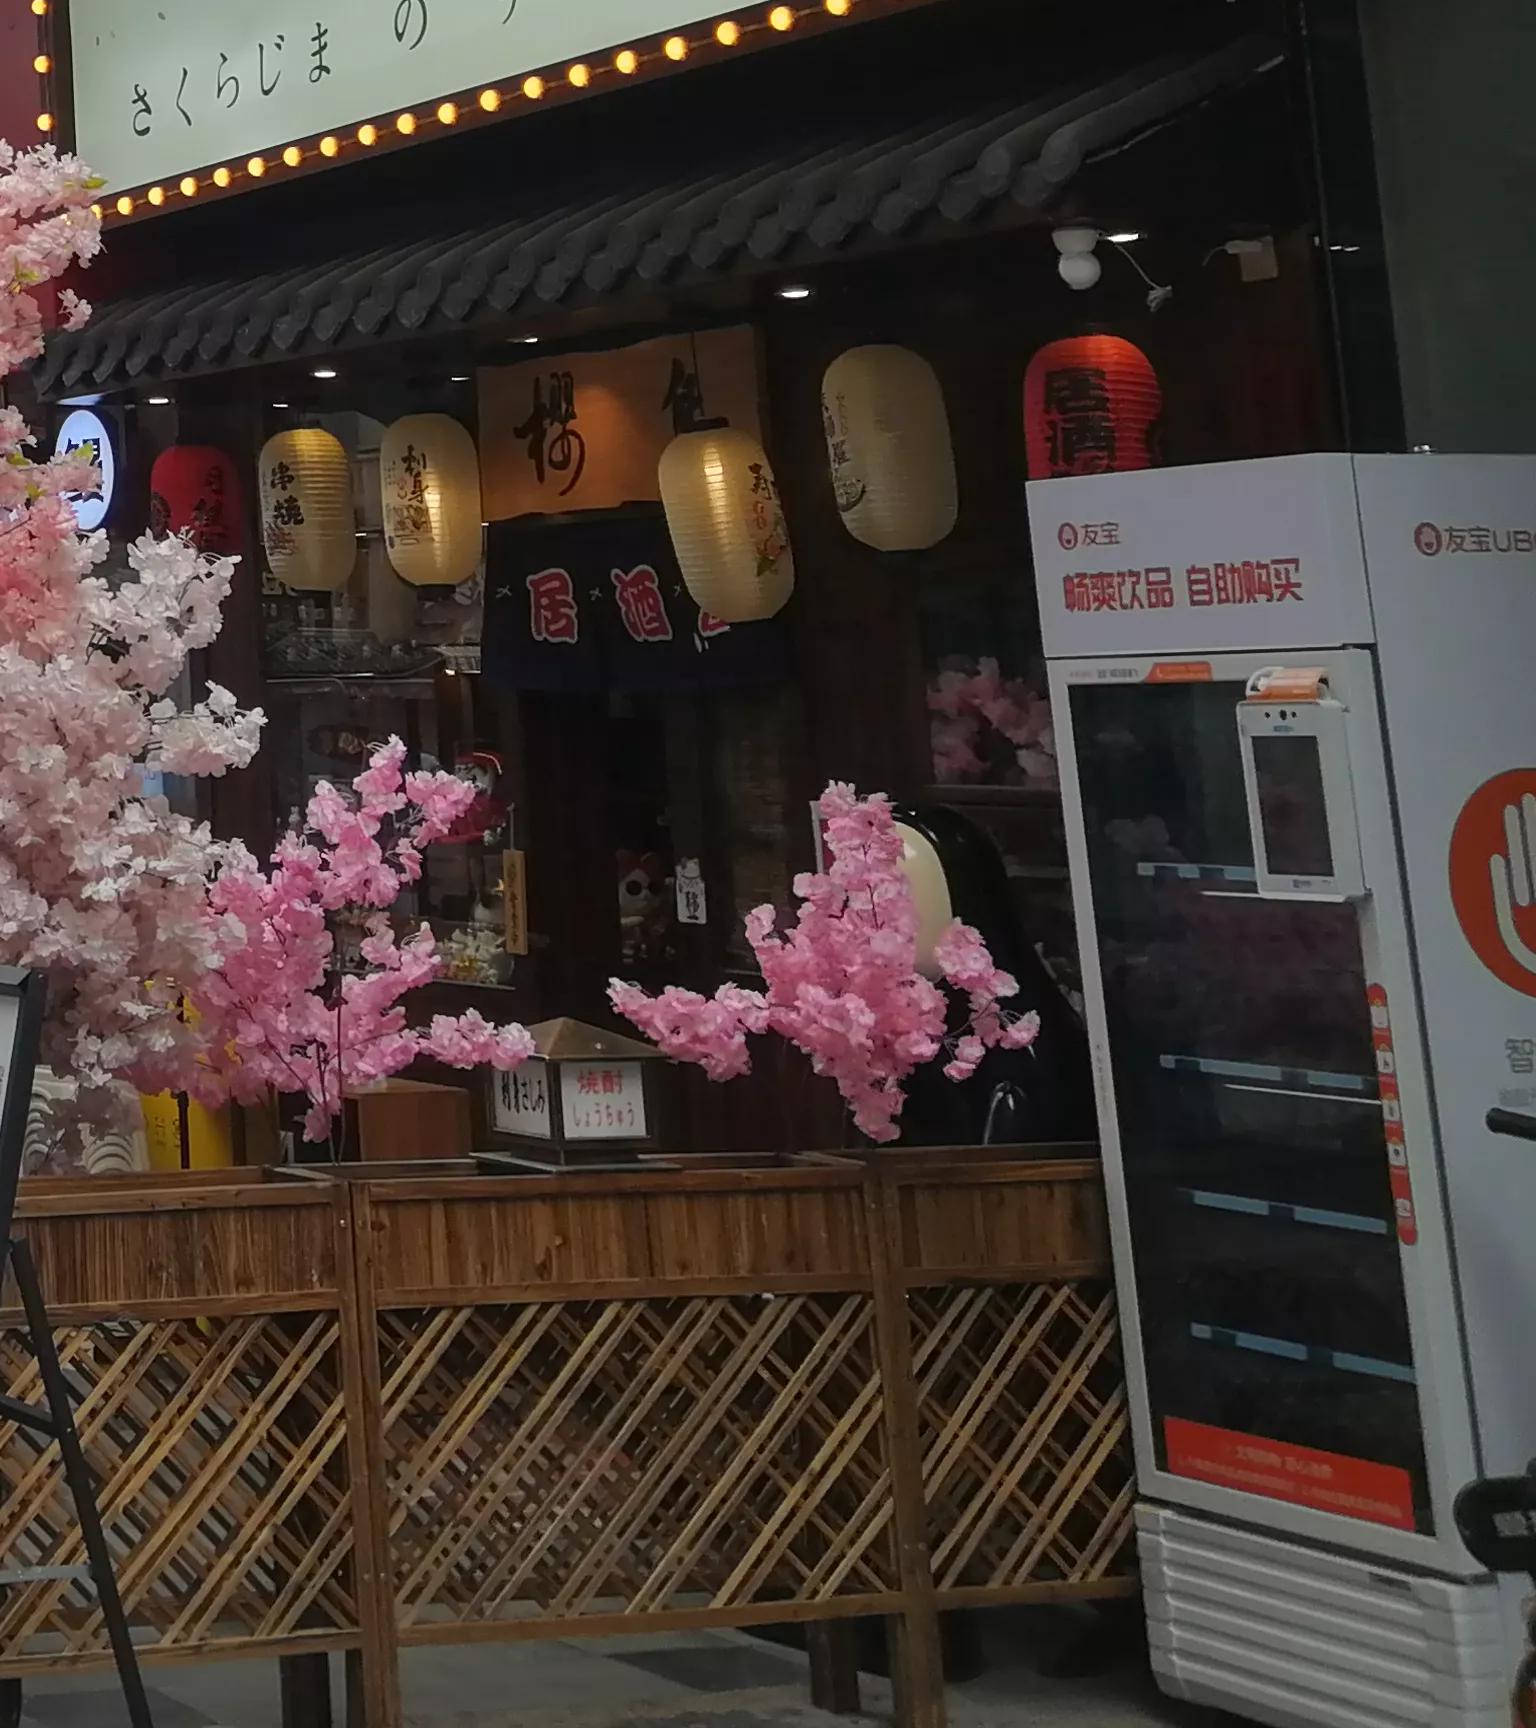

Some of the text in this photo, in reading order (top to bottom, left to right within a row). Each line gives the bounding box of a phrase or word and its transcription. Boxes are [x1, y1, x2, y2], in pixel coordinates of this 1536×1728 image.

[128, 20, 331, 140] さくらじま
[1080, 522, 1121, 546] 友宝
[526, 564, 731, 645] 居酒
[1062, 557, 1305, 613] 畅爽饮品 自助购买
